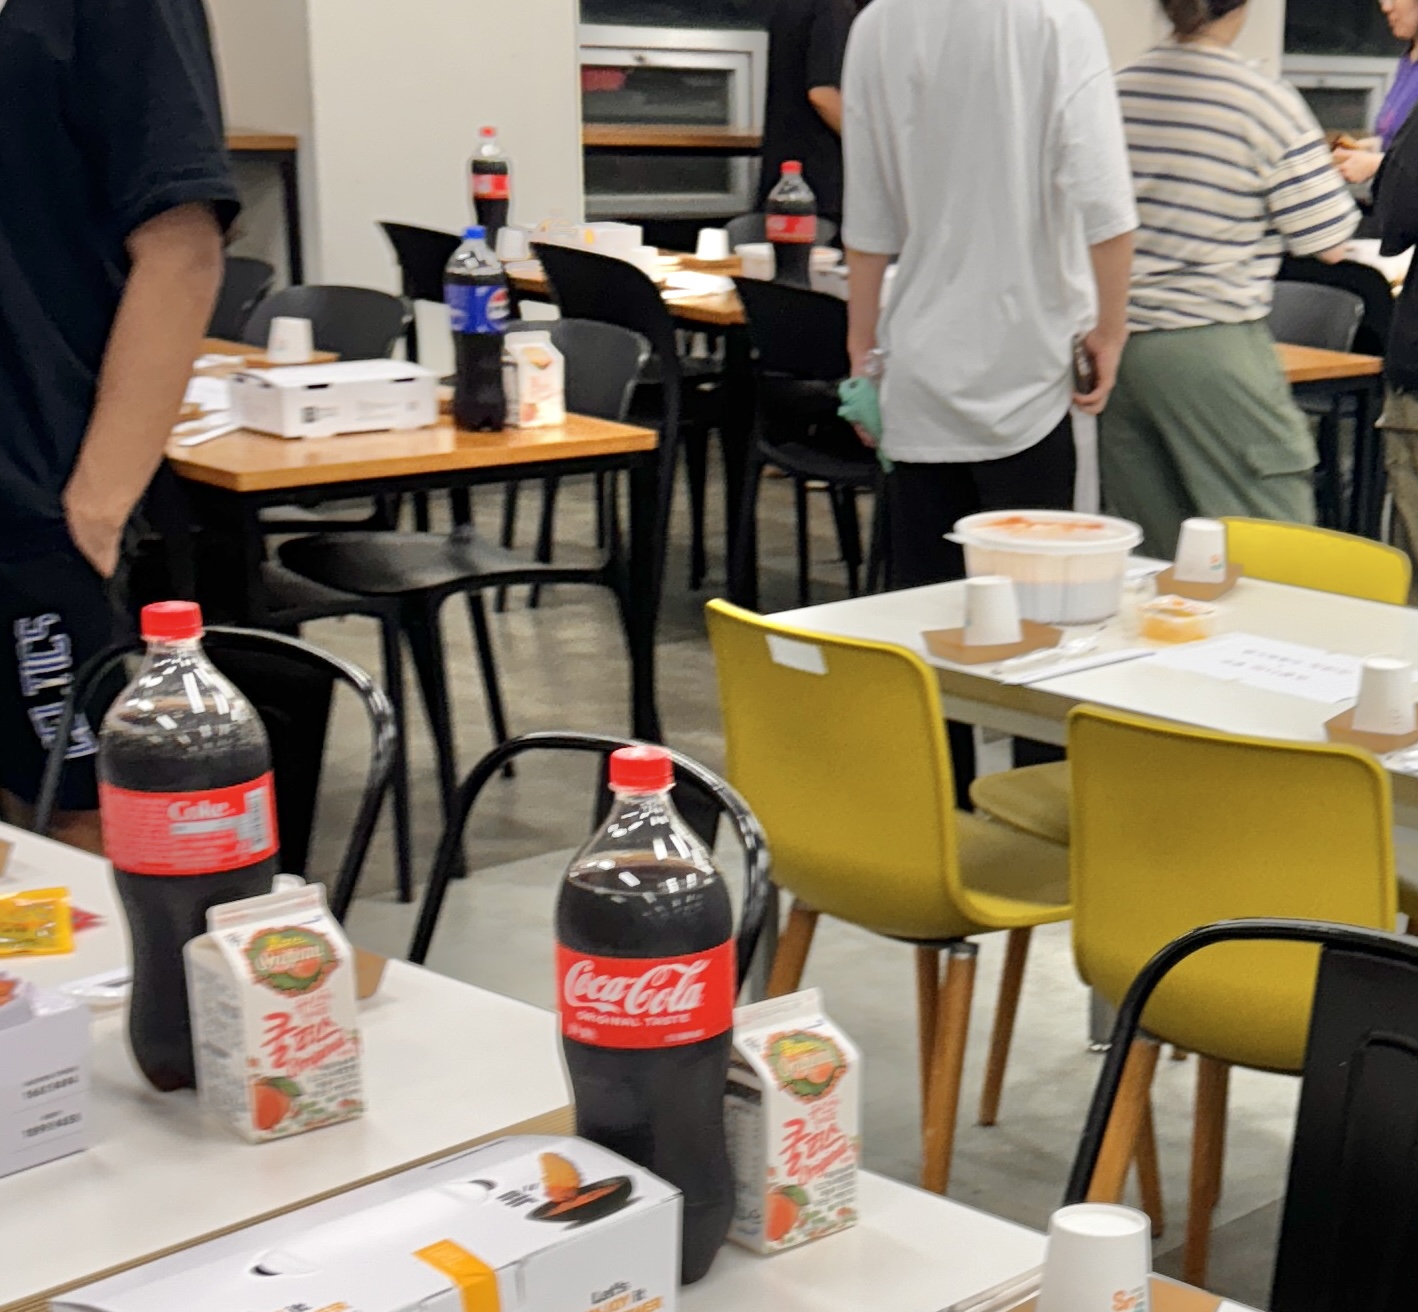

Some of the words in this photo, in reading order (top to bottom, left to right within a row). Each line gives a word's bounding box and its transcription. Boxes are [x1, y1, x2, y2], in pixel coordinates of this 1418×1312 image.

[166, 799, 236, 822] Coke
[563, 959, 712, 1016] Coca-Cola
[575, 1010, 644, 1027] ORIGINAL
[645, 1012, 692, 1027] TASTE
